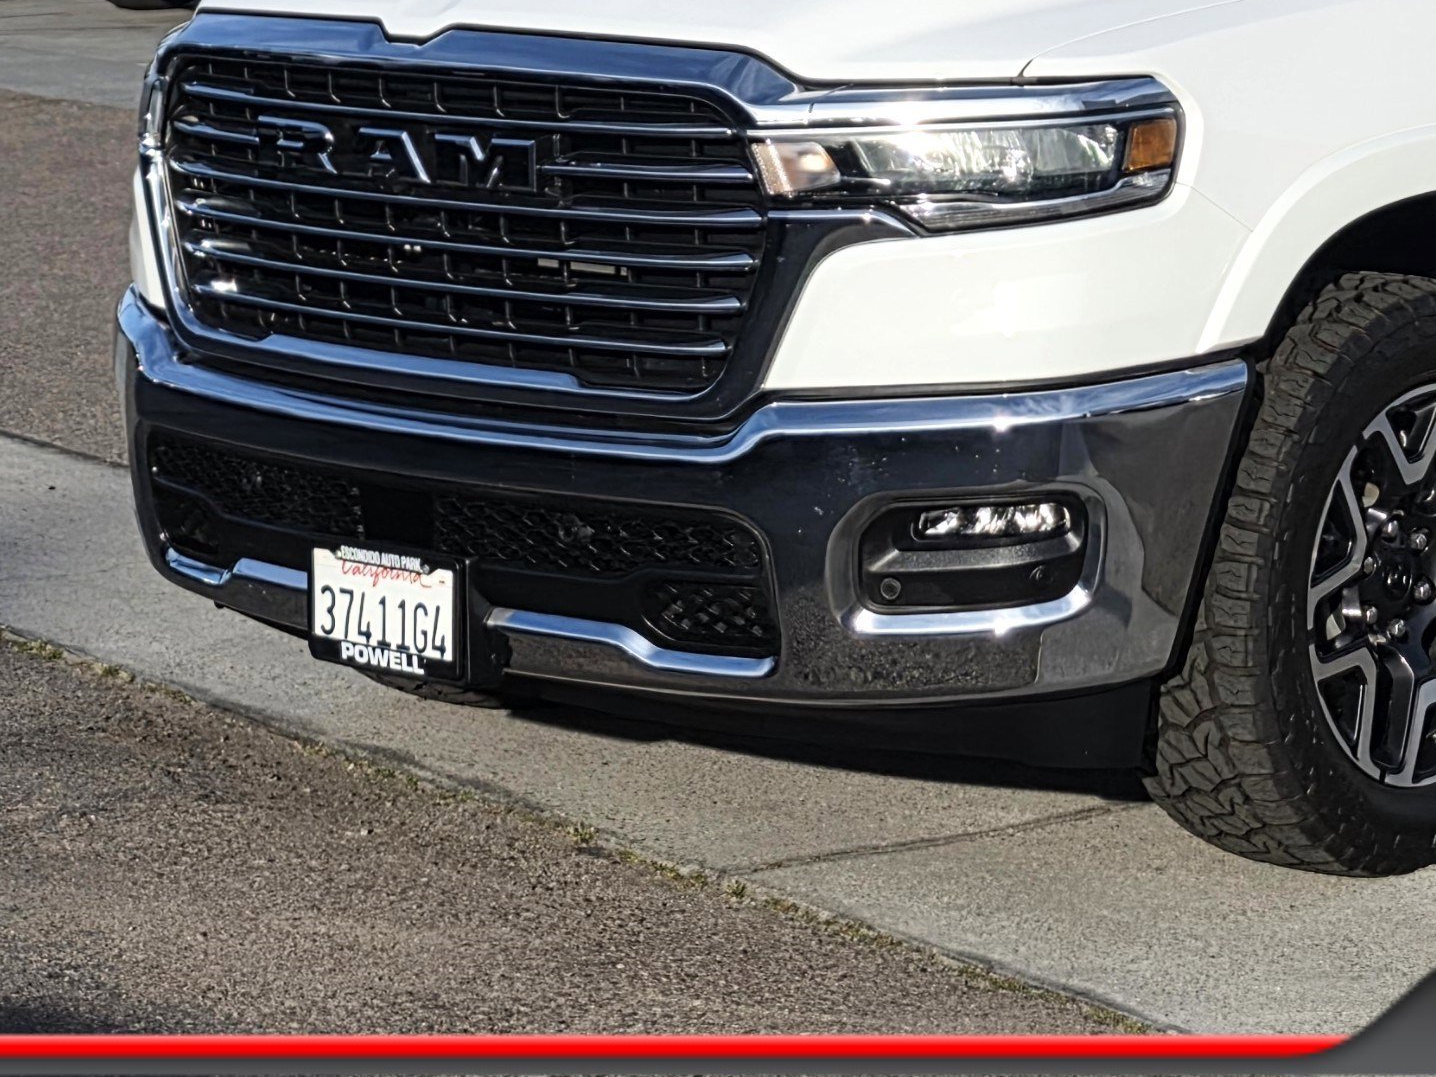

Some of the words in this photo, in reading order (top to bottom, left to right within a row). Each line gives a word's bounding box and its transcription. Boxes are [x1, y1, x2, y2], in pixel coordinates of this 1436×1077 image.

[257, 114, 538, 192] RAM
[340, 544, 381, 565] ESCONDIDO
[381, 552, 400, 568] AUTO
[401, 555, 423, 574] PARK
[320, 583, 447, 659] 37411G4
[340, 640, 425, 675] POWELL
